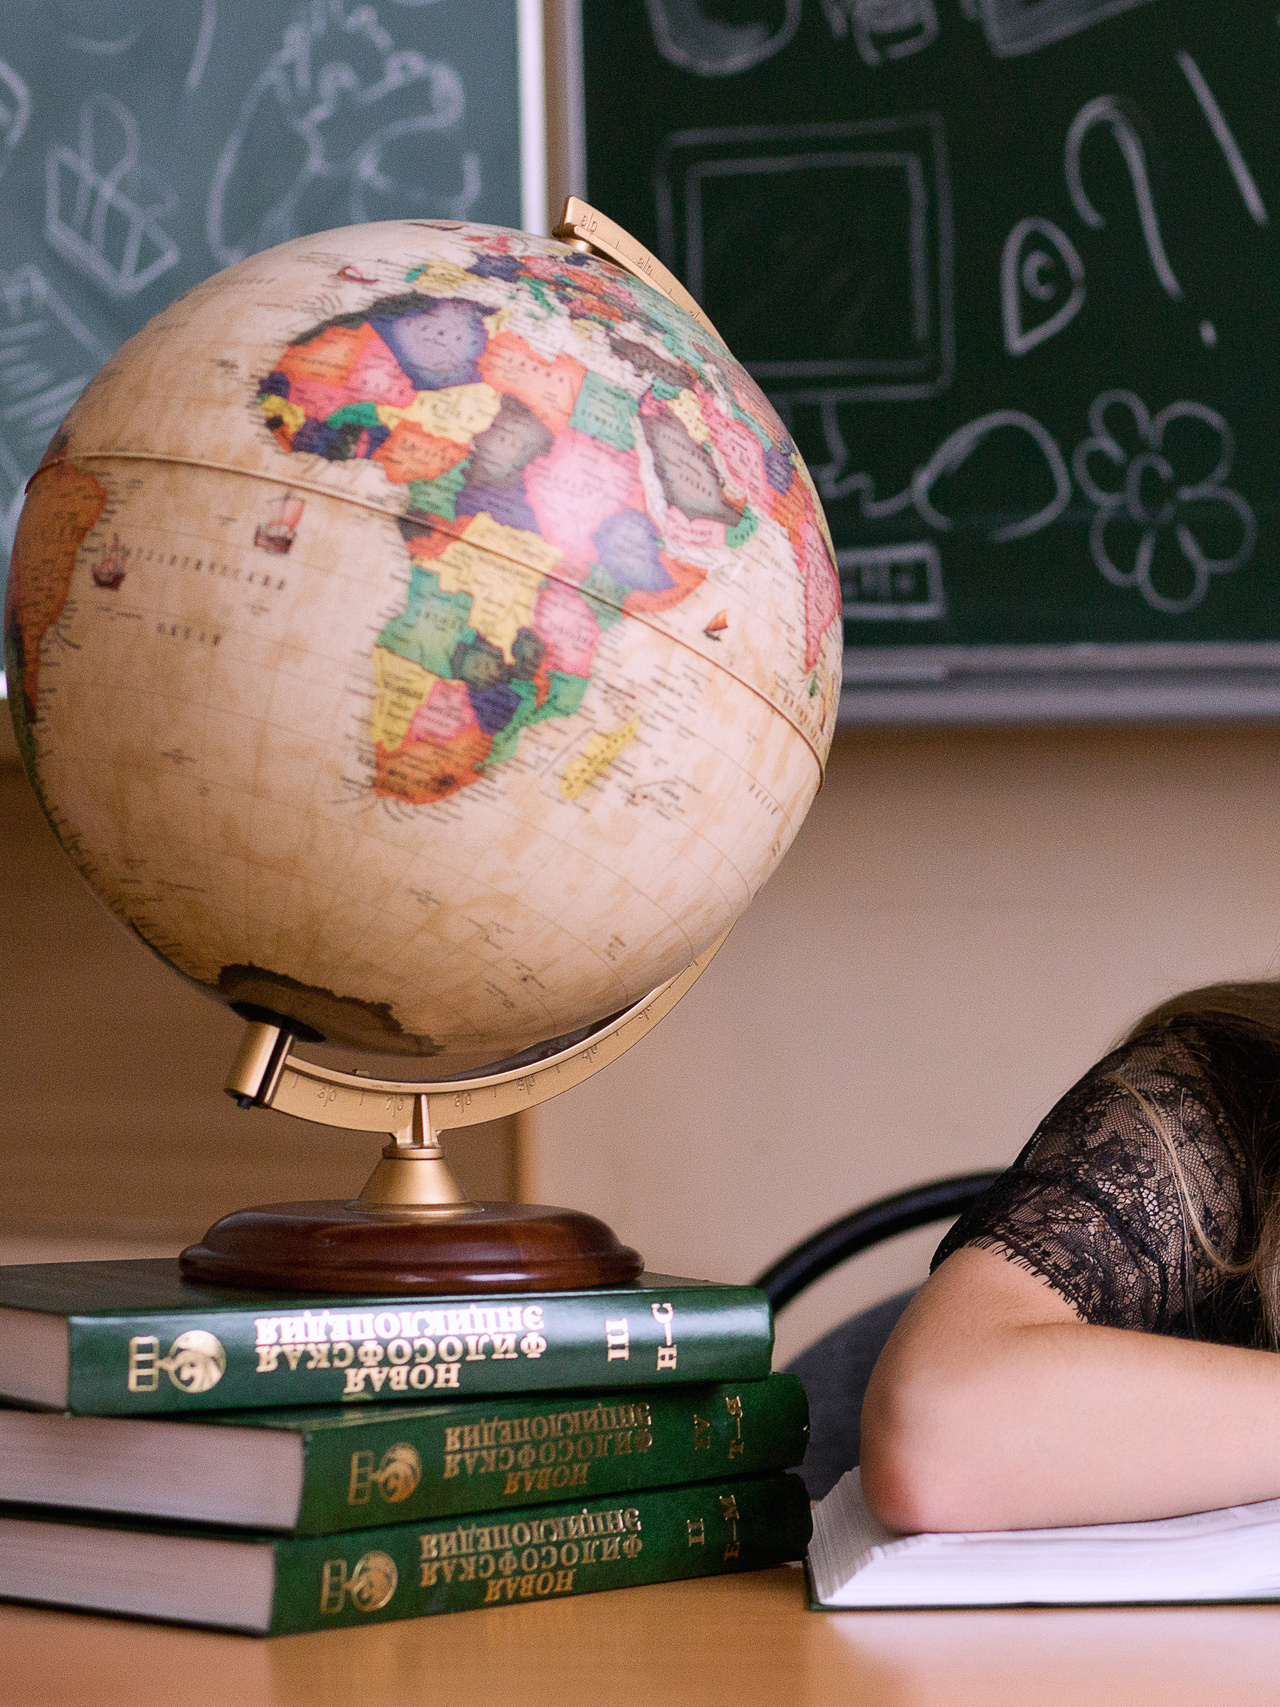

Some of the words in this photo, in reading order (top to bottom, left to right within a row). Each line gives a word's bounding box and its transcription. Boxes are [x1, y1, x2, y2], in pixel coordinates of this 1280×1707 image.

[253, 1304, 545, 1345] ЭНЦИКЛОПЕДИЯ
[255, 1331, 548, 1373] ФИЛОСОФСКАЯ
[343, 1363, 461, 1393] НОВАЯ
[443, 1402, 652, 1451] ЭНЦИКЛОПЕДИЯ
[443, 1428, 653, 1479] ФИЛОСОФСКАЯ
[503, 1461, 592, 1495] НОВАЯ
[418, 1507, 642, 1560] ЭНЦИКЛОПЕДИЯ
[419, 1533, 643, 1588] ФИЛОСОФСКАЯ
[483, 1568, 578, 1603] НОВАЯ
